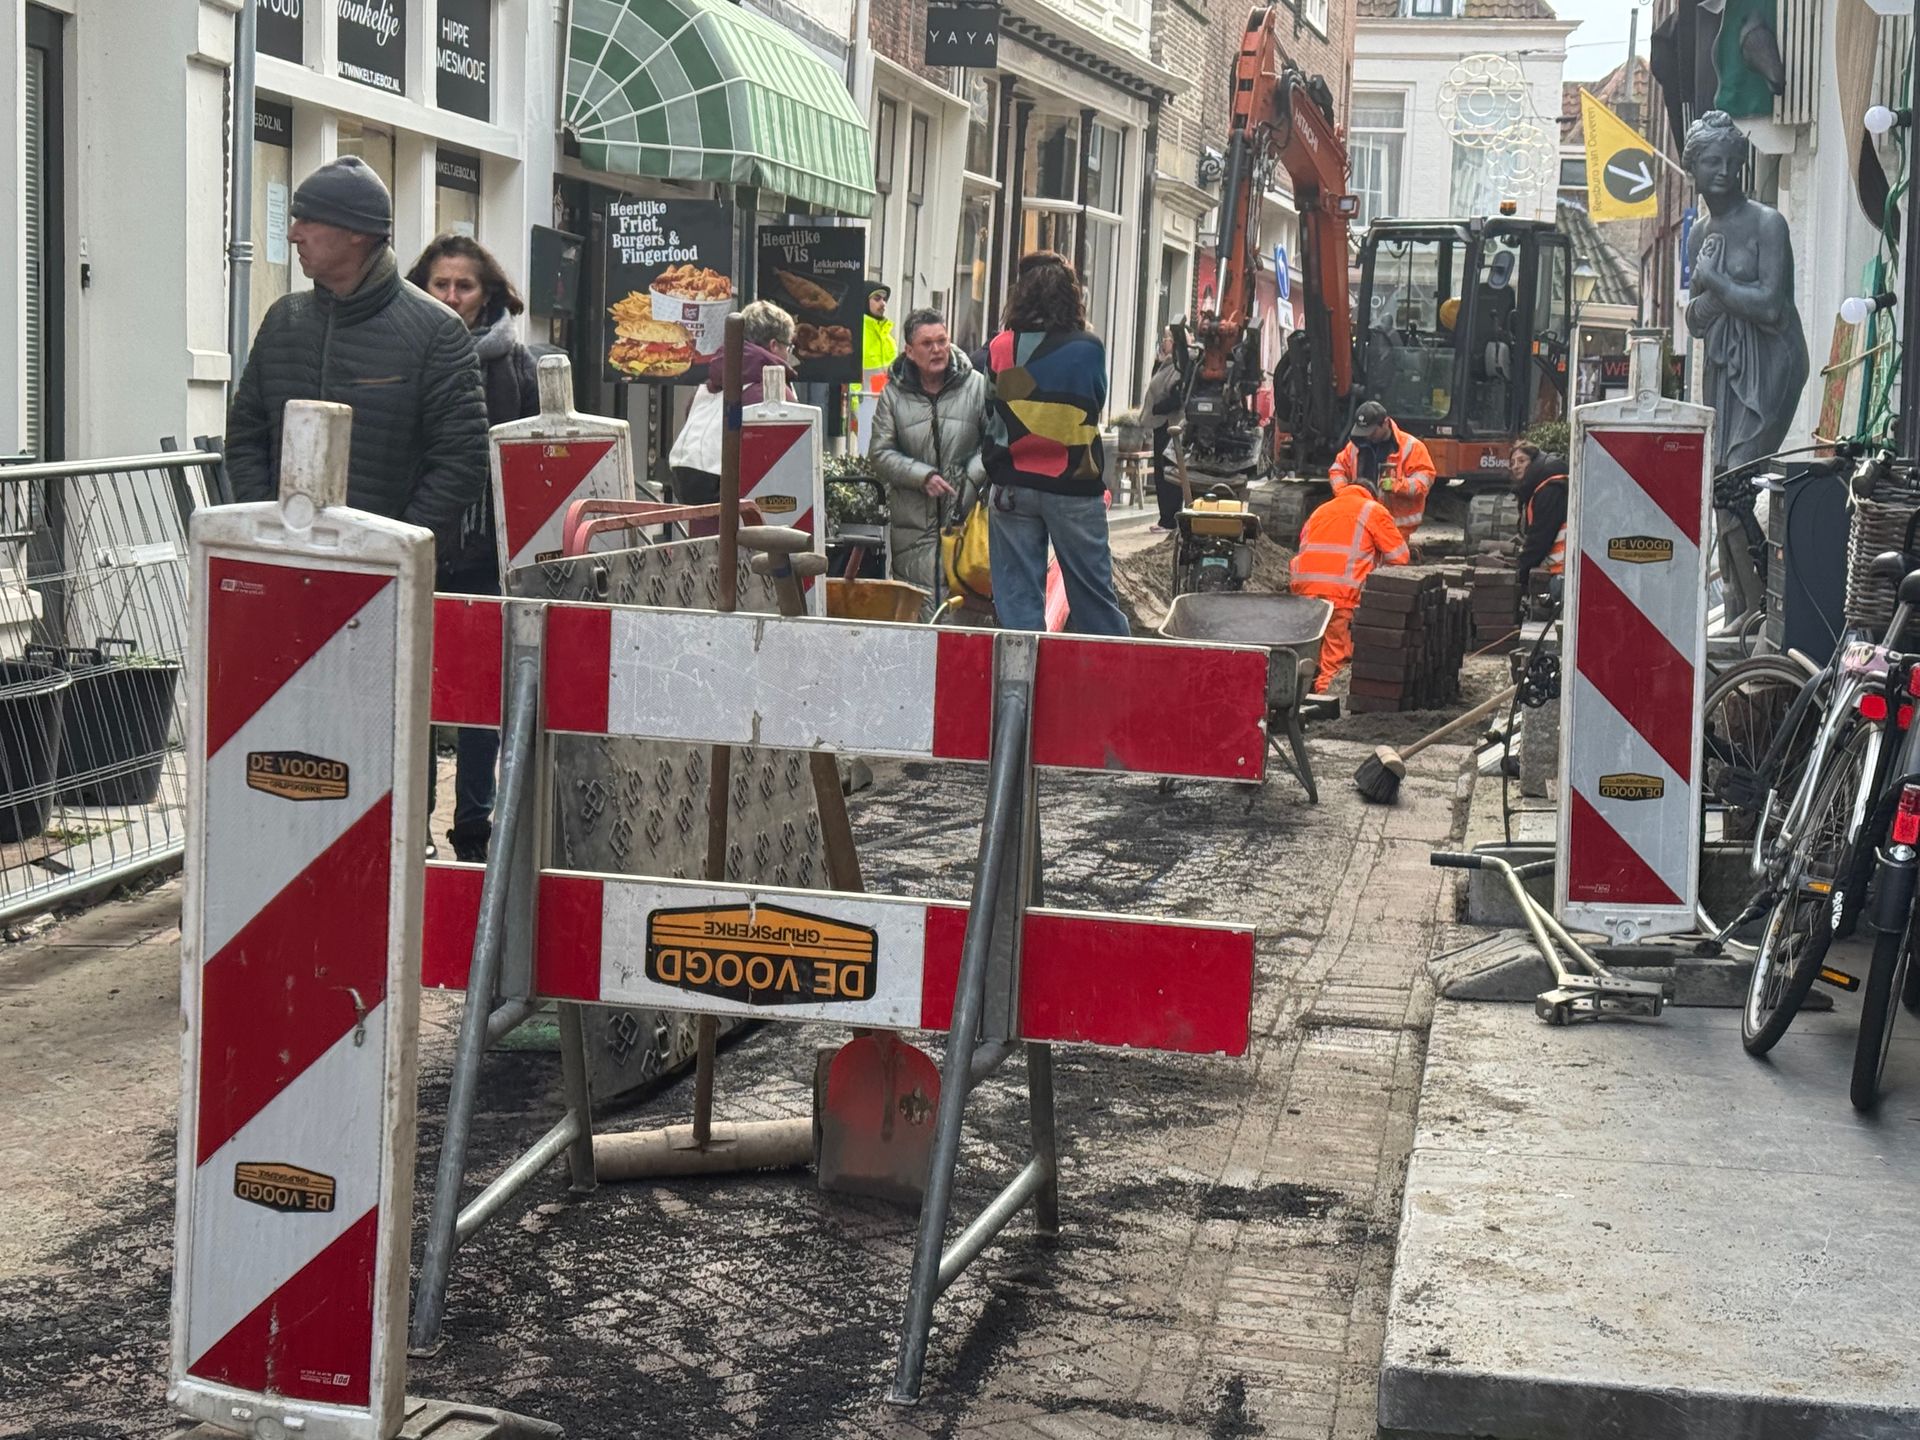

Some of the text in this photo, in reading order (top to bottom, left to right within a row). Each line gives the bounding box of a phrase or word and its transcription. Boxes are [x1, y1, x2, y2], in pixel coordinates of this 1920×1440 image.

[442, 17, 470, 48] HIPPE
[929, 30, 995, 45] YAYA
[1295, 107, 1319, 153] HITACHI
[610, 201, 667, 217] Heerlijke
[619, 216, 663, 234] Friet,
[612, 230, 680, 250] Burgers &
[762, 230, 820, 247] Heerlijke
[621, 245, 698, 267] Fingerfood
[783, 245, 809, 263] Vis
[813, 260, 861, 271] Lekkerbekje
[1611, 540, 1670, 550] DE VOOGD
[250, 753, 344, 780] DE VOOGD
[1602, 786, 1661, 798] DE VOOGD
[704, 921, 820, 943] GRIJPSKERKE
[656, 950, 865, 998] DE VOOGD
[238, 1182, 330, 1211] DE VOOGD
